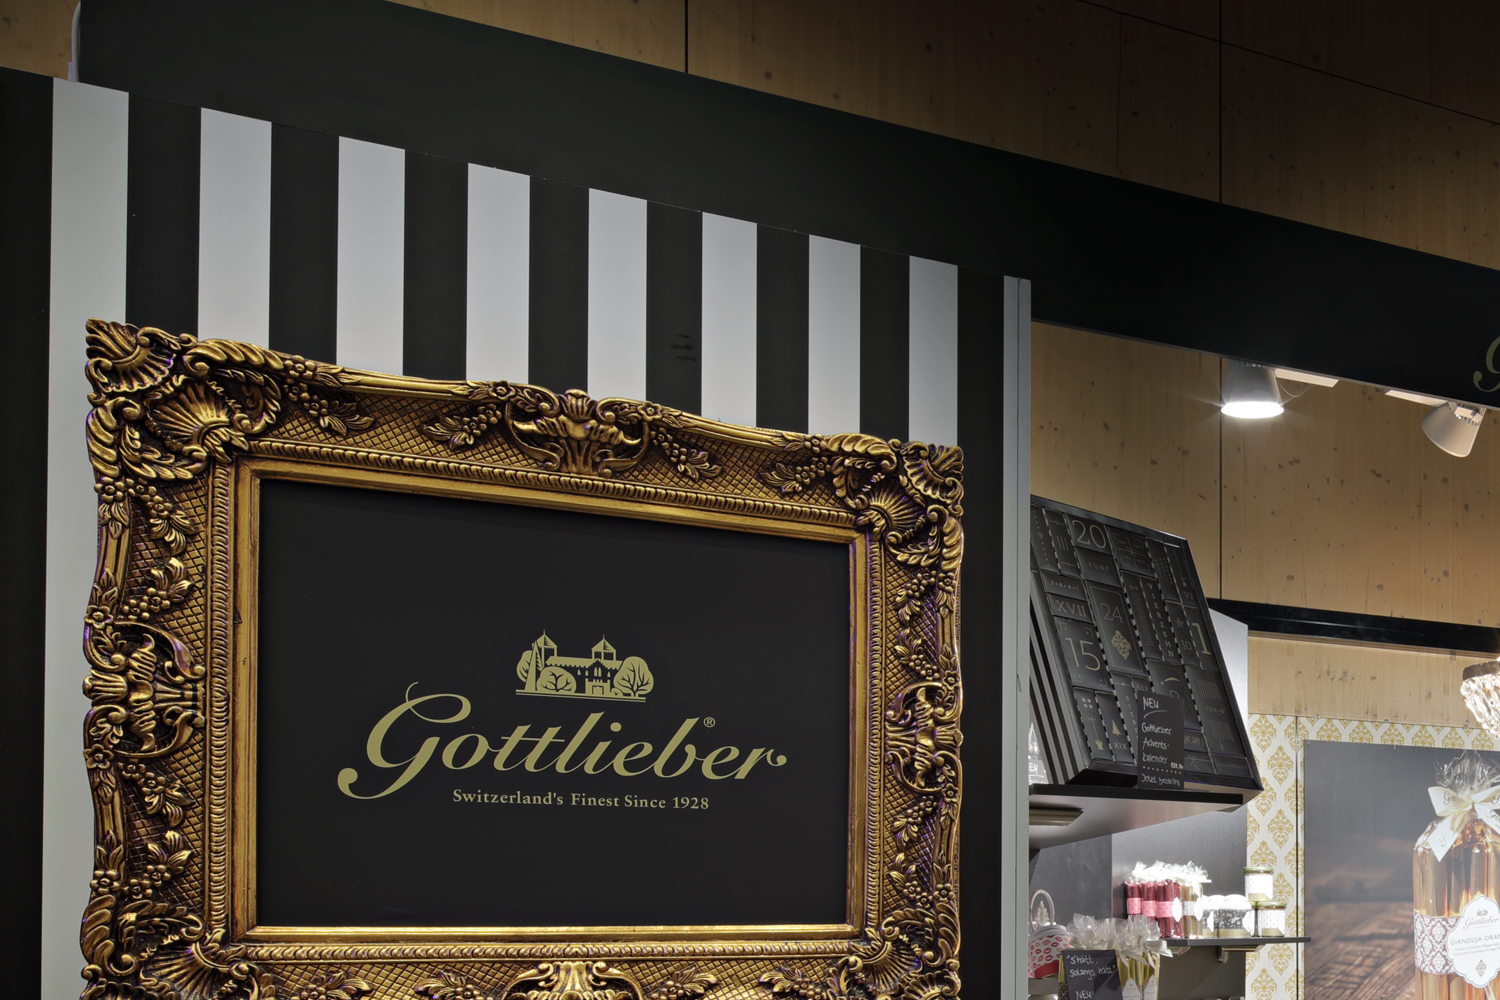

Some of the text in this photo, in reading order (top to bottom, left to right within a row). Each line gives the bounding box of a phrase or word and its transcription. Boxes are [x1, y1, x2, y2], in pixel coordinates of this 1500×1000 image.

[1071, 519, 1107, 549] 20
[1088, 561, 1110, 572] FÜNF
[1055, 600, 1088, 618] XVII
[1100, 603, 1124, 624] 24
[1064, 637, 1101, 672] 15
[1142, 696, 1159, 711] NEU
[337, 681, 788, 800] Gottlieber
[1113, 742, 1127, 750] XIX
[452, 788, 710, 811] Switzerland's Finest Since 1928
[1463, 915, 1500, 930] Gottlieber
